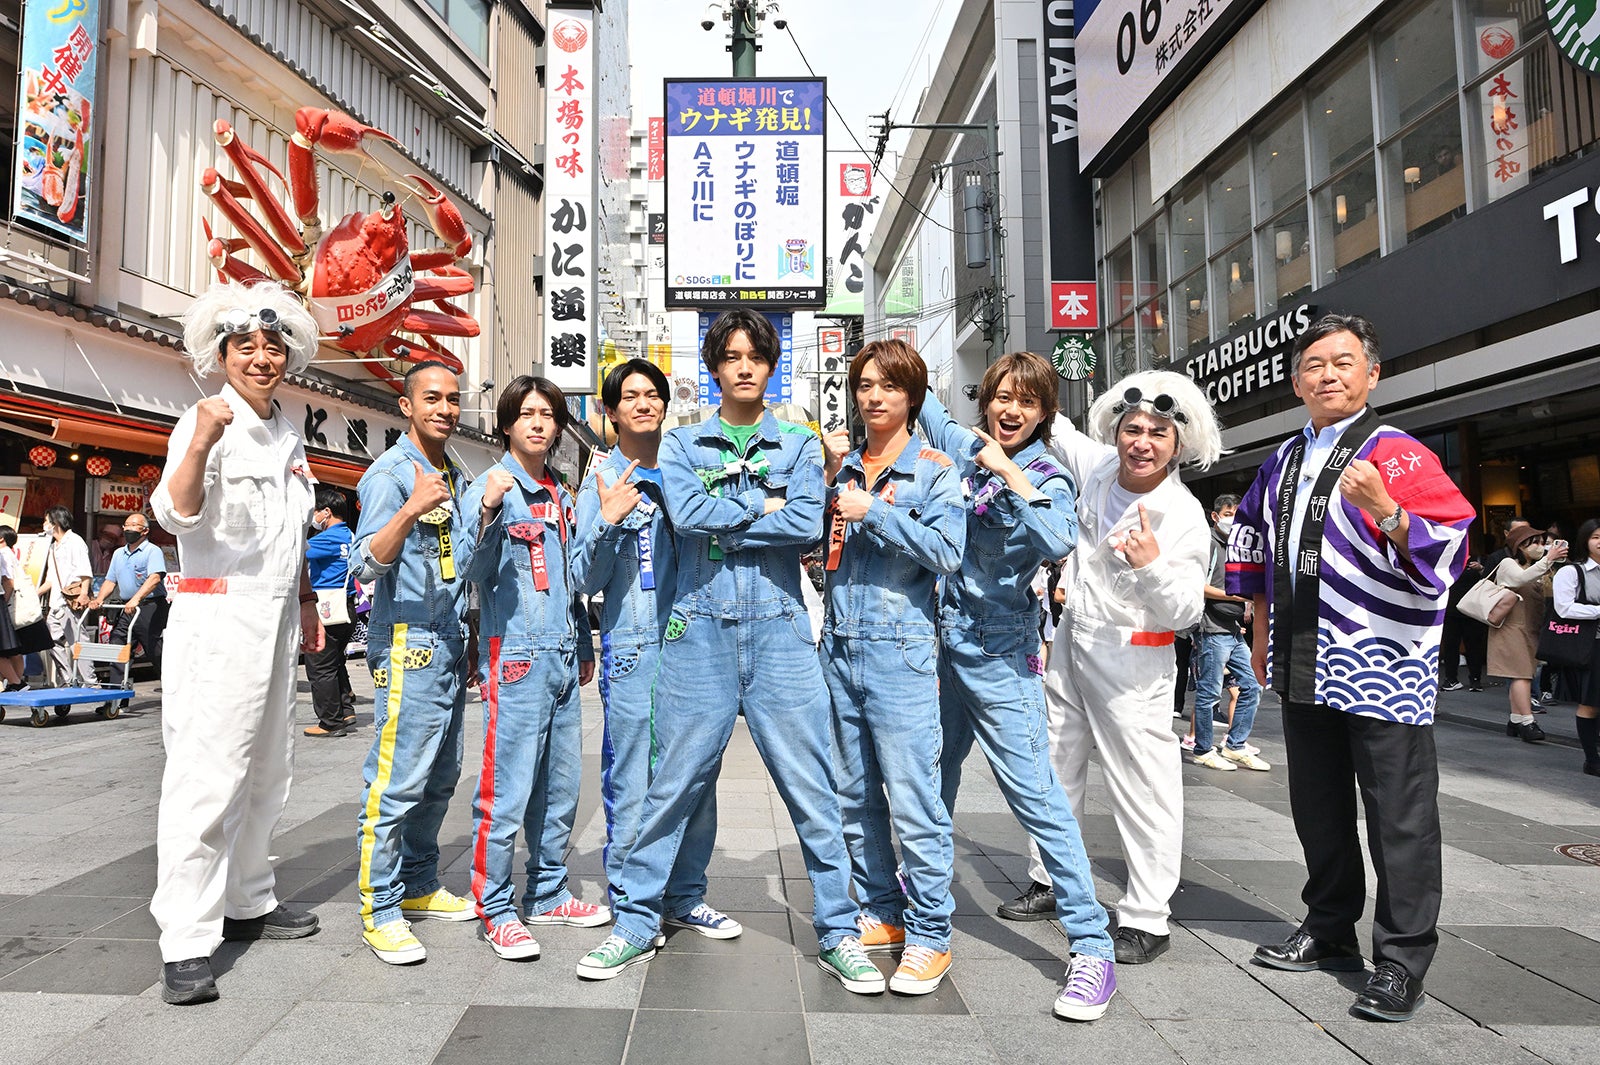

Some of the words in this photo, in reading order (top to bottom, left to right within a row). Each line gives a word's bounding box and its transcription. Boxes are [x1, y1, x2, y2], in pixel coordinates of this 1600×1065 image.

[42, 22, 93, 95] 開催中
[1155, 0, 1214, 75] 株式会社
[554, 64, 585, 179] 本場の味
[679, 107, 811, 133] ウナギ発見!
[697, 87, 794, 106] 道頓堀川で
[775, 140, 800, 206] 道頓堀
[734, 140, 758, 281] ウナギのぼりに
[1543, 187, 1600, 265] T
[841, 195, 880, 293] がんこ
[674, 290, 727, 300] 道頓堀商店会
[686, 275, 711, 285] SDGs
[1058, 290, 1089, 320] 本
[1185, 303, 1311, 380] STARBUCKS
[1206, 353, 1286, 406] COFFEE
[1382, 450, 1421, 484] 大阪
[1282, 487, 1293, 512] Town
[1298, 445, 1353, 577] 道頓堀
[640, 528, 653, 573] MASSA
[1277, 513, 1290, 567] Community
